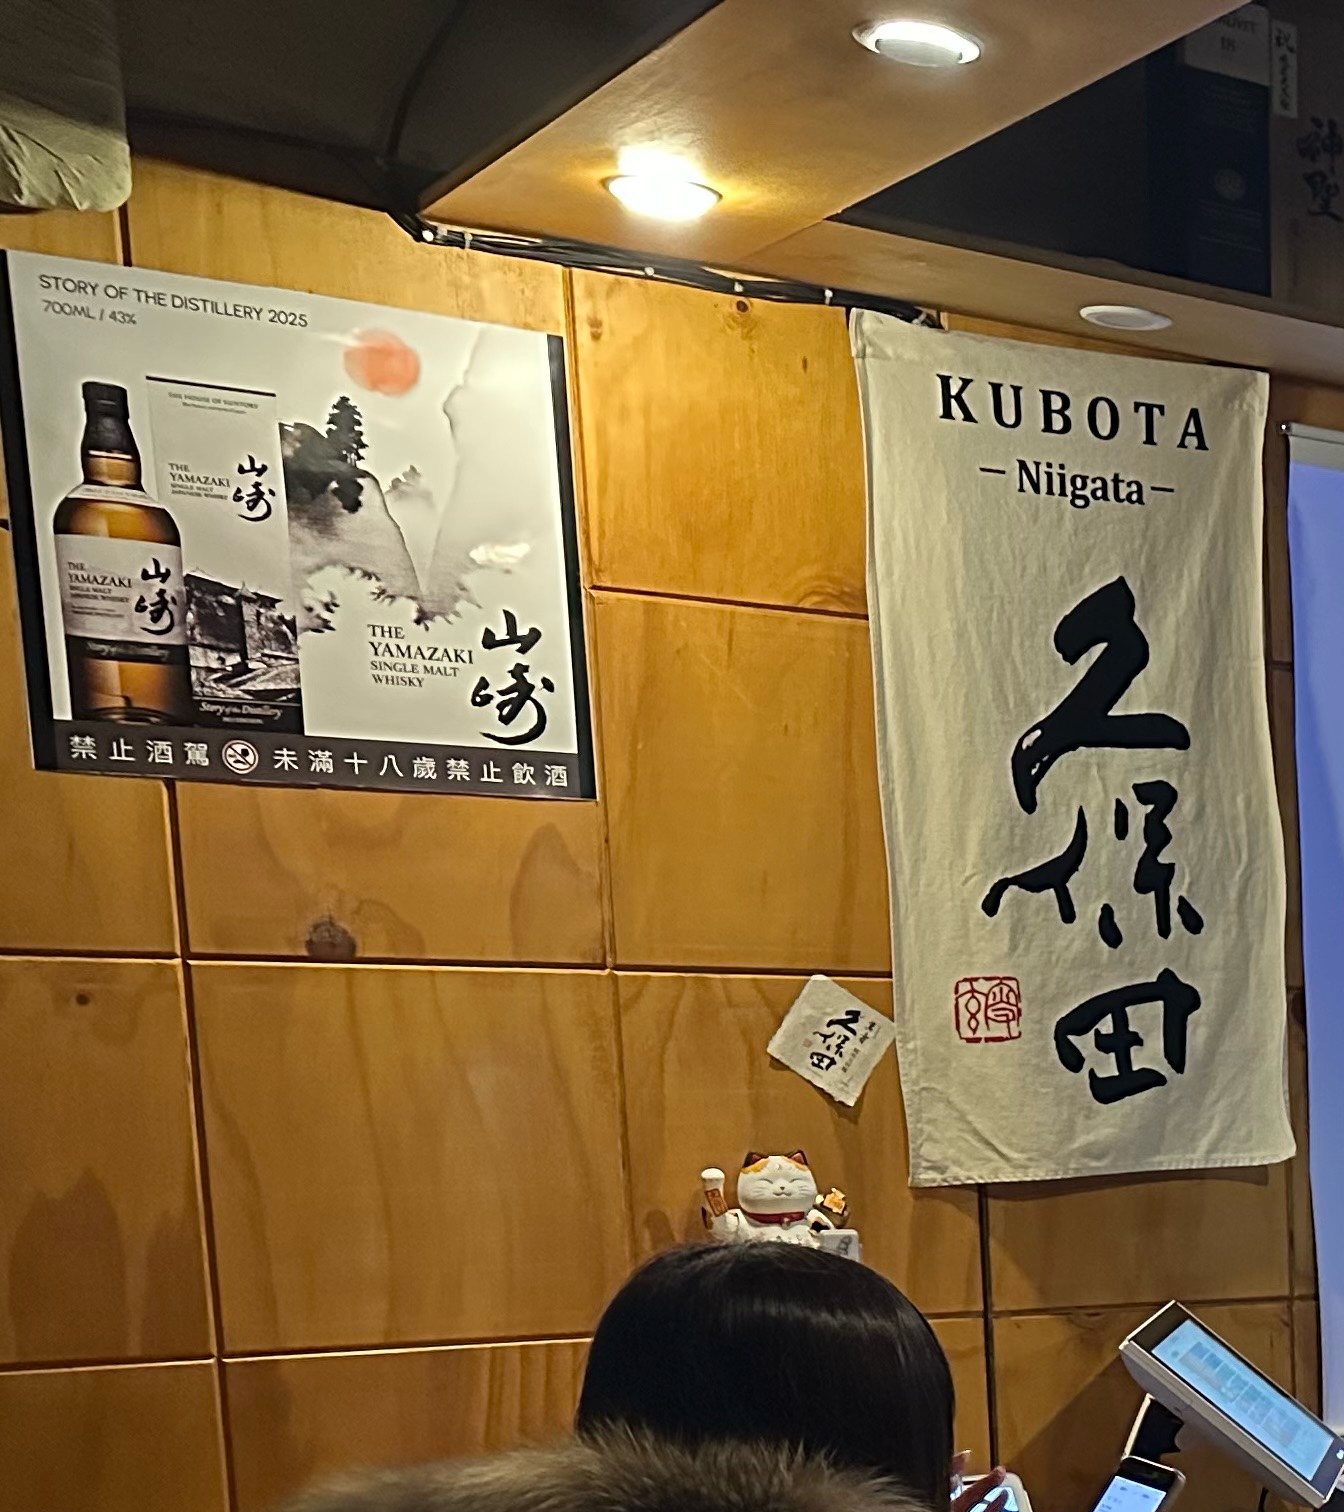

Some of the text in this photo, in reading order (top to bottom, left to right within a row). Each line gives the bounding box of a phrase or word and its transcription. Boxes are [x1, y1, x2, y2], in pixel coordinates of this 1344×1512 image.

[38, 273, 309, 328] STORY OF THE DISTILLERY 2025
[42, 299, 96, 320] 700ML
[108, 310, 138, 325] 43%
[935, 373, 1209, 451] KUBOTA
[168, 463, 190, 472] THE
[169, 472, 231, 488] YAMAZAKI
[1016, 459, 1146, 510] Niigata
[68, 573, 132, 589] YAMAZAKI
[367, 624, 405, 640] THE
[368, 641, 474, 665] YAMAZAKI
[370, 661, 460, 677] SINGLE MALT
[371, 674, 425, 688] WHISKY
[70, 735, 210, 767] 禁止酒駕
[272, 748, 569, 789] 未滿十八歲禁止飲酒
[981, 575, 1204, 1105] 久保田
